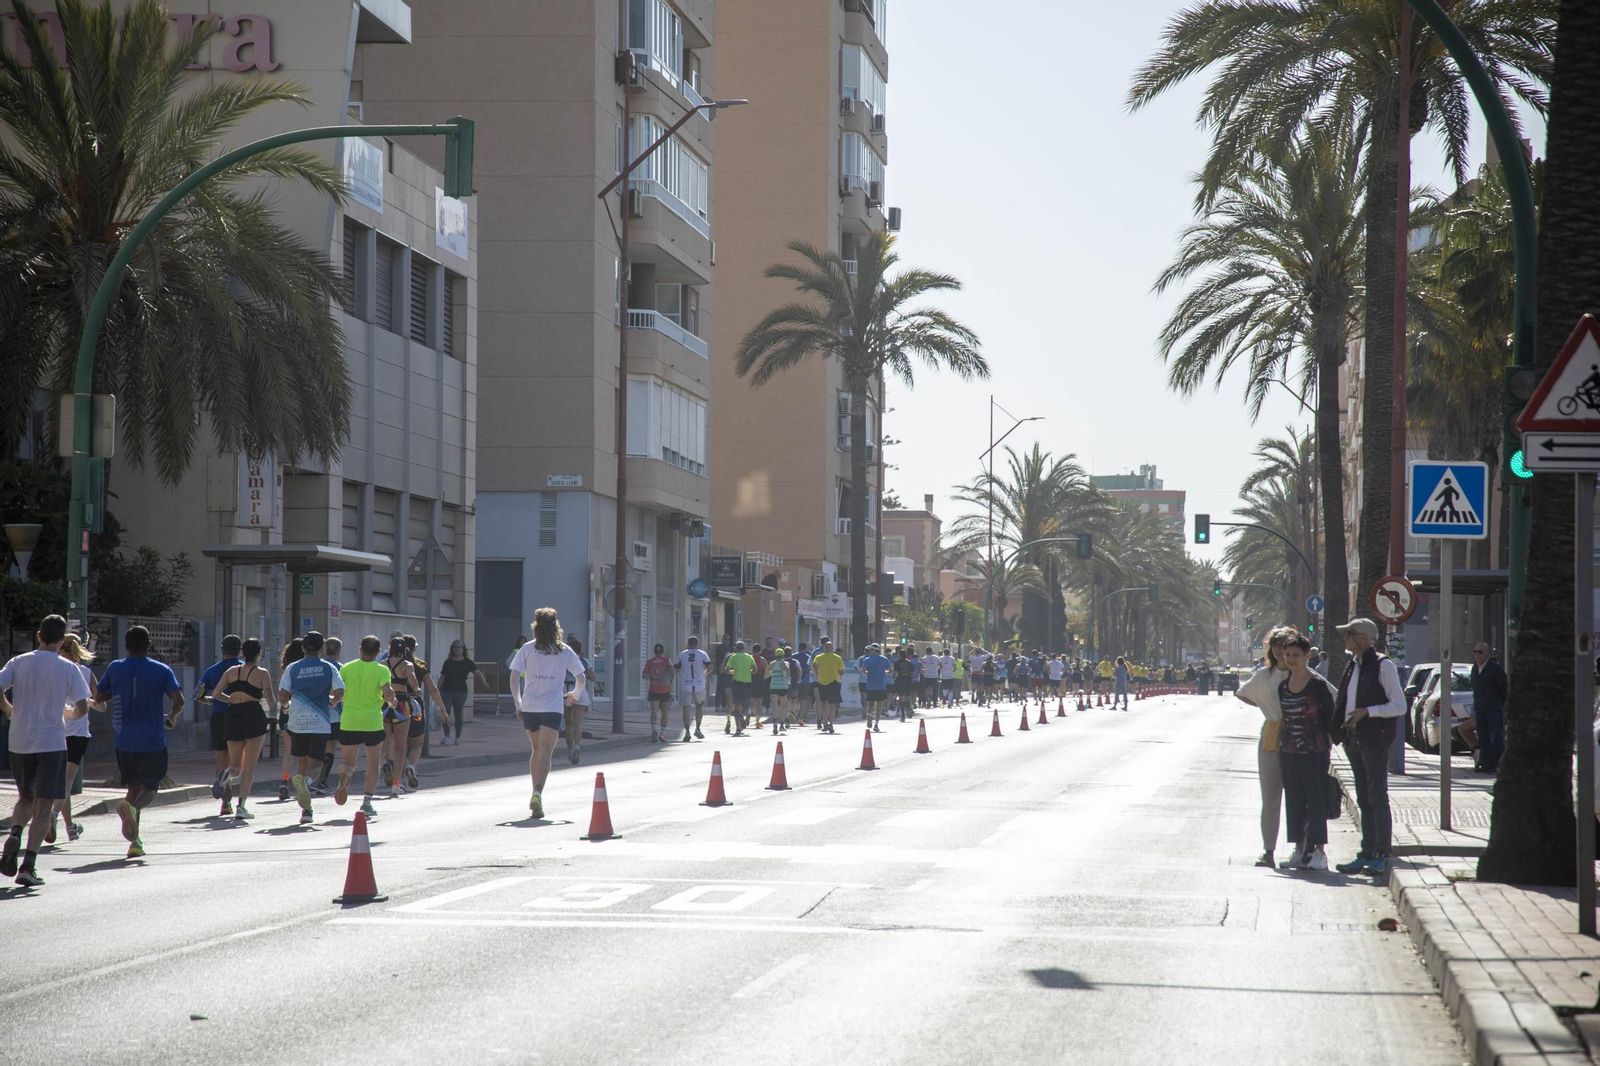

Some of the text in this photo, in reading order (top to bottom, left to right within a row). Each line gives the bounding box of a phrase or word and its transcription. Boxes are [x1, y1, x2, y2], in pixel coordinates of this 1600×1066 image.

[247, 455, 265, 525] amara
[688, 653, 695, 662] 2
[521, 882, 779, 912] 30
